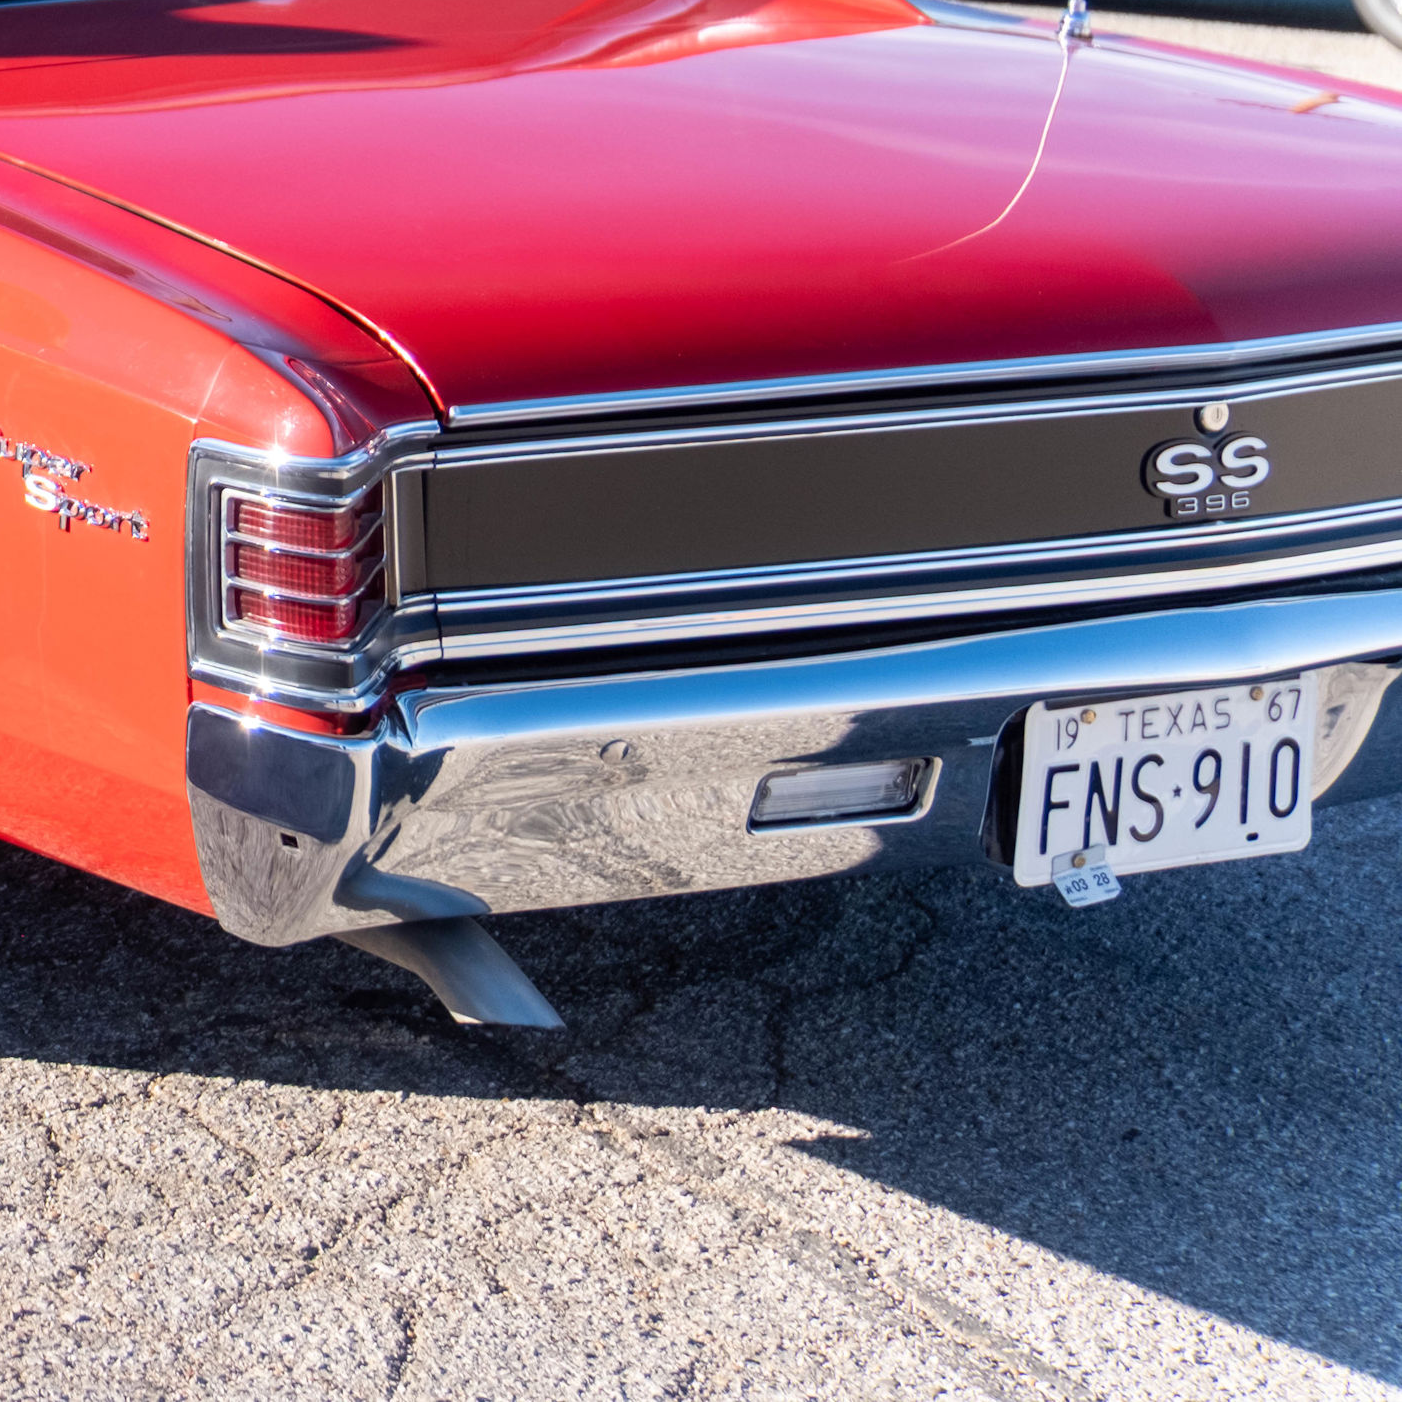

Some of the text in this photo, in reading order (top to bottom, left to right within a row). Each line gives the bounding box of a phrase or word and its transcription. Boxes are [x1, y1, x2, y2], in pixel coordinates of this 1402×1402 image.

[1155, 436, 1270, 495] SS
[24, 474, 150, 541] Sport
[1177, 490, 1250, 515] 396
[1056, 688, 1302, 751] 19 TEXAS 67
[1071, 878, 1089, 892] 03
[1093, 871, 1110, 886] 28
